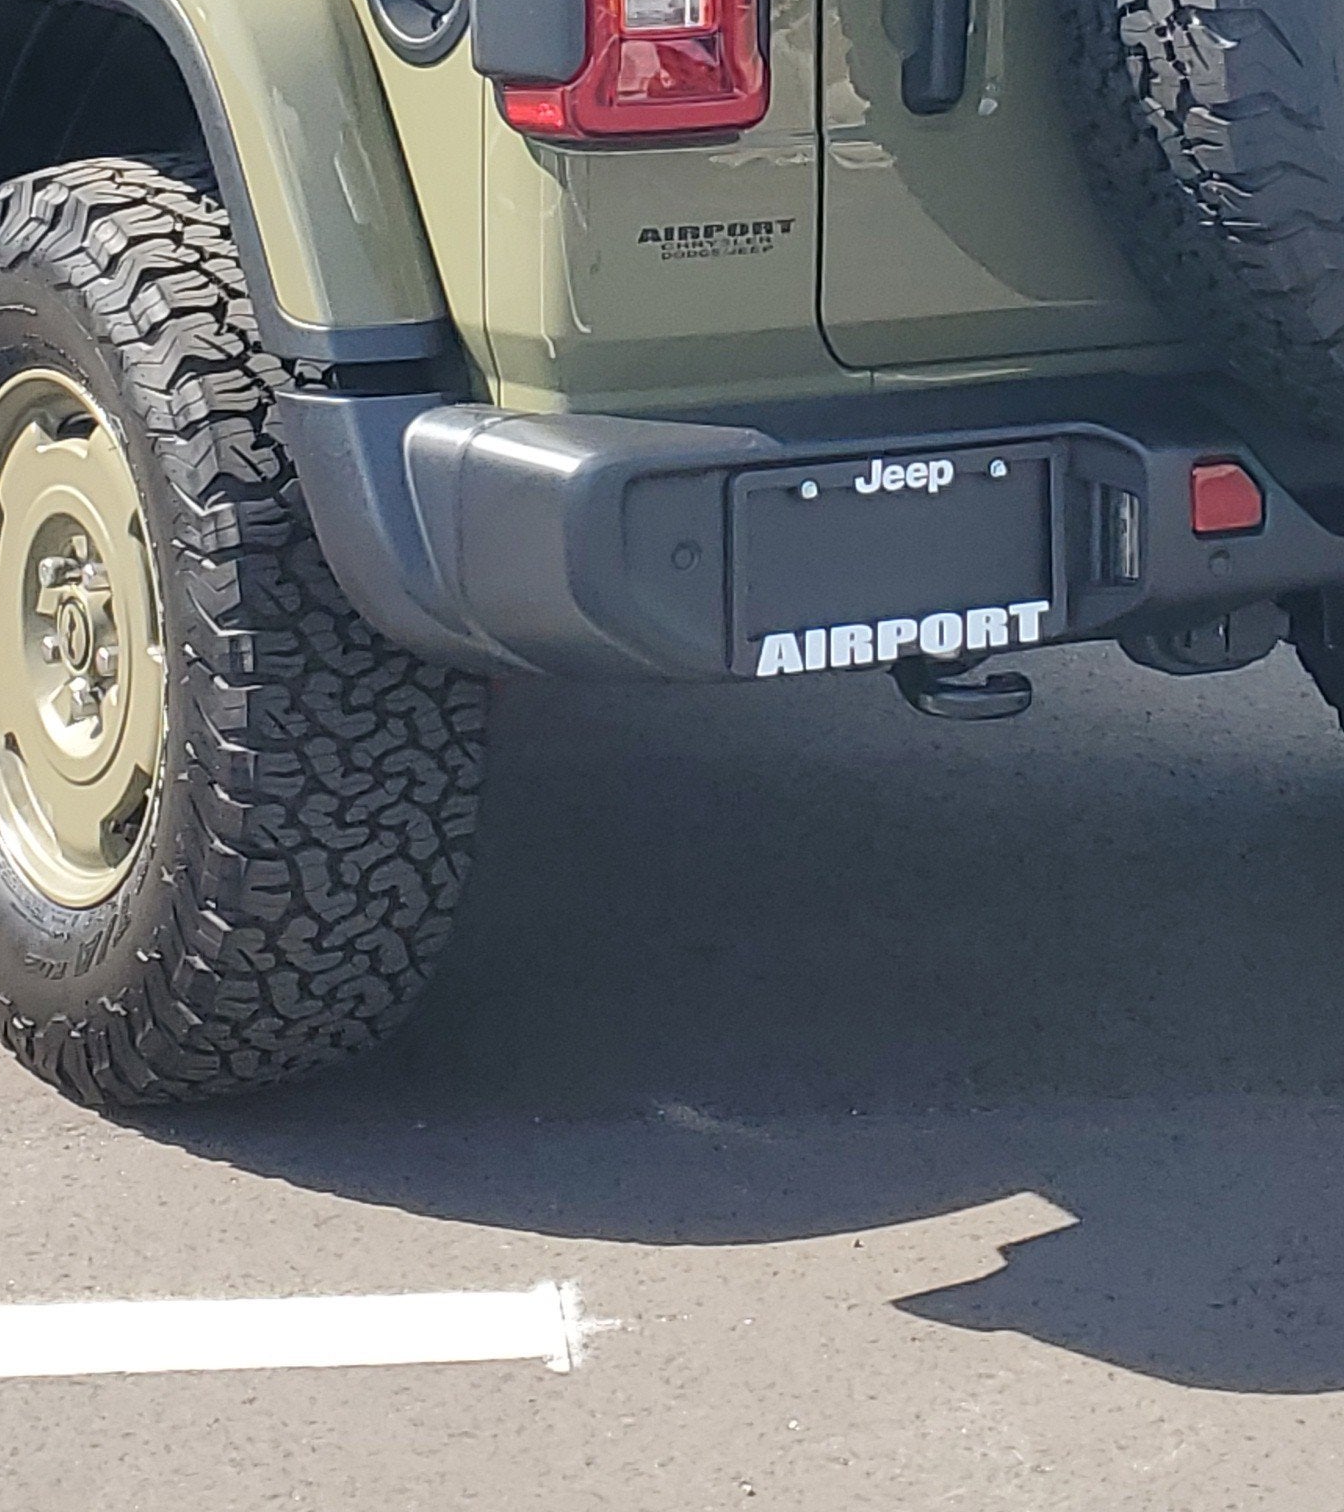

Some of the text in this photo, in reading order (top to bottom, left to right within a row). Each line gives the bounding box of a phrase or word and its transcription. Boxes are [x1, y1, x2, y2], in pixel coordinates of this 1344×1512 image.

[638, 218, 796, 244] AIRPORT
[855, 459, 954, 494] Jeep
[756, 600, 1050, 677] AIRPORT
